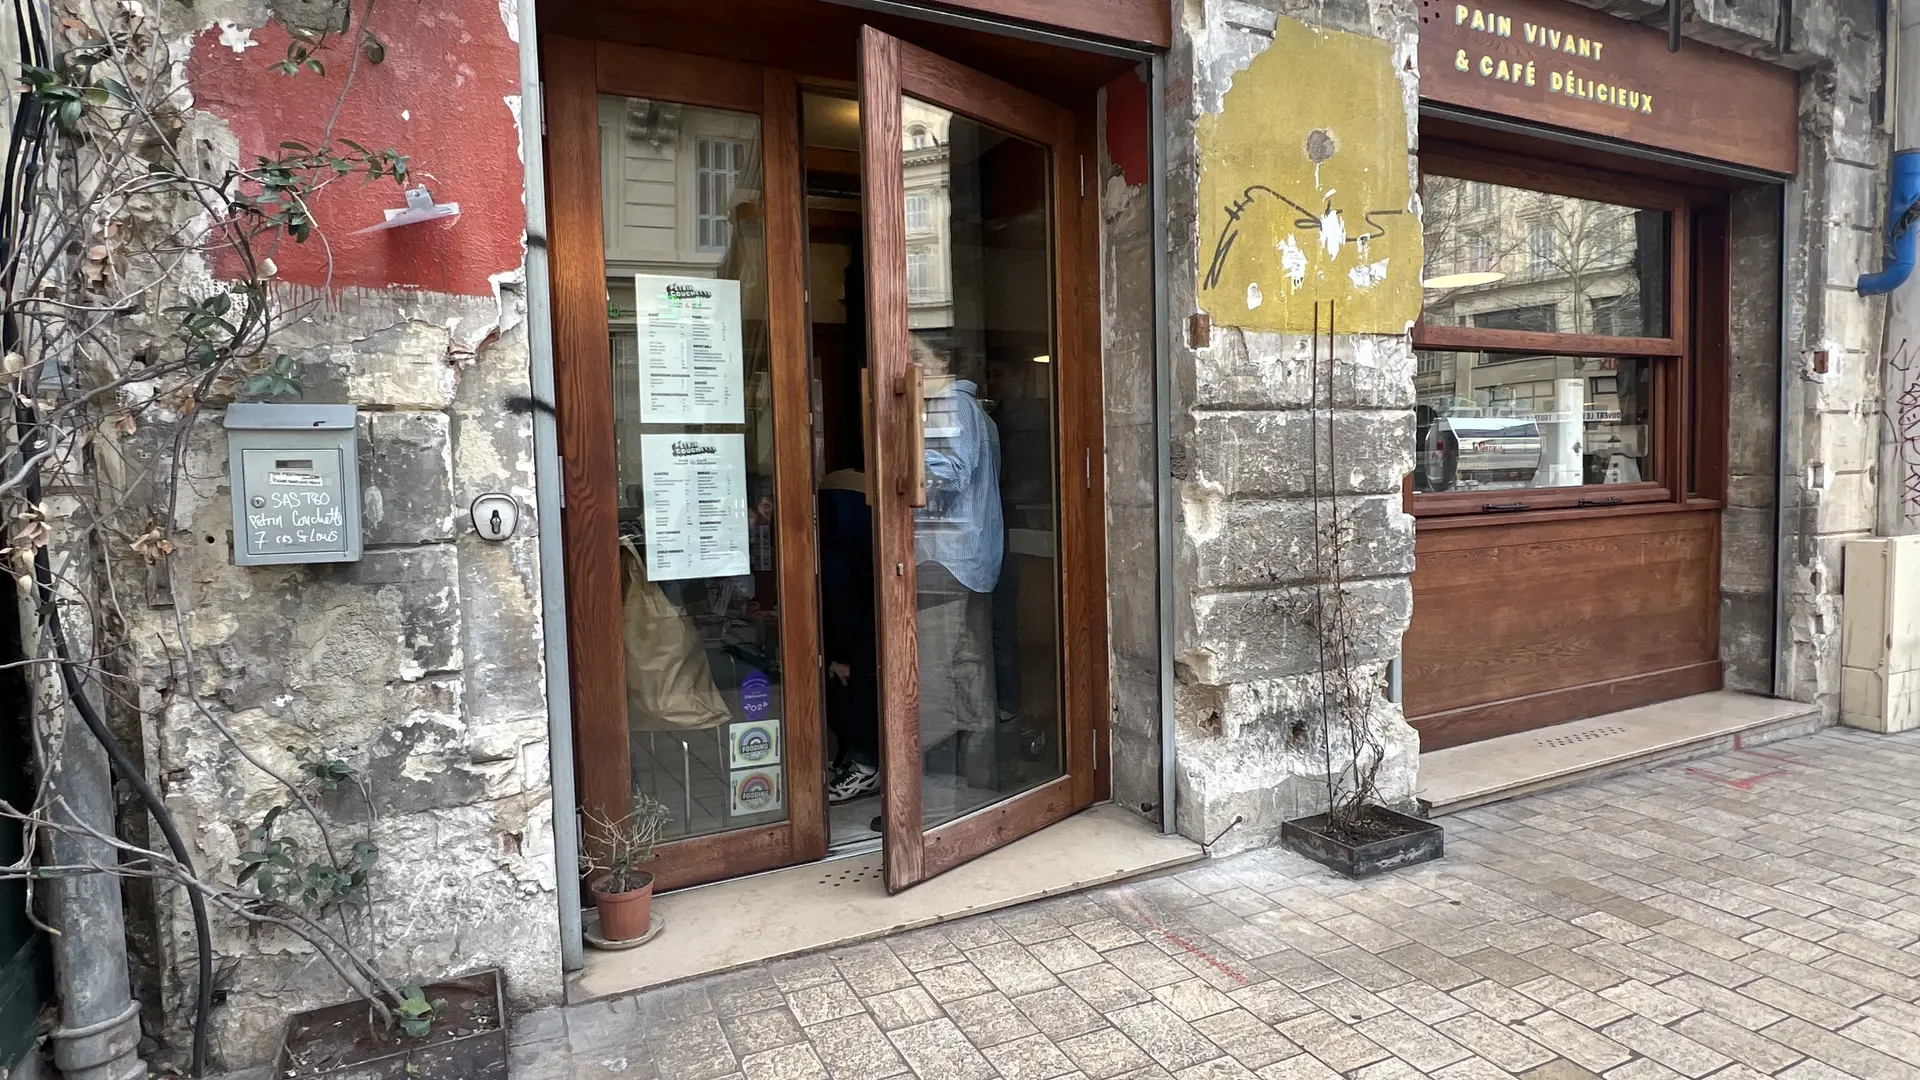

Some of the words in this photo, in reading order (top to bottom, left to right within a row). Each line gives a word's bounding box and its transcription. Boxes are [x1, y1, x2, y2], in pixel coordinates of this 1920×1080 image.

[1456, 4, 1512, 38] PAIN
[1523, 22, 1603, 62] VIVANT
[1454, 49, 1470, 72] &
[1479, 59, 1536, 87] CAFÉ
[1550, 69, 1653, 114] DÉLICIEUX
[271, 491, 301, 509] SAS
[254, 530, 269, 549] 7
